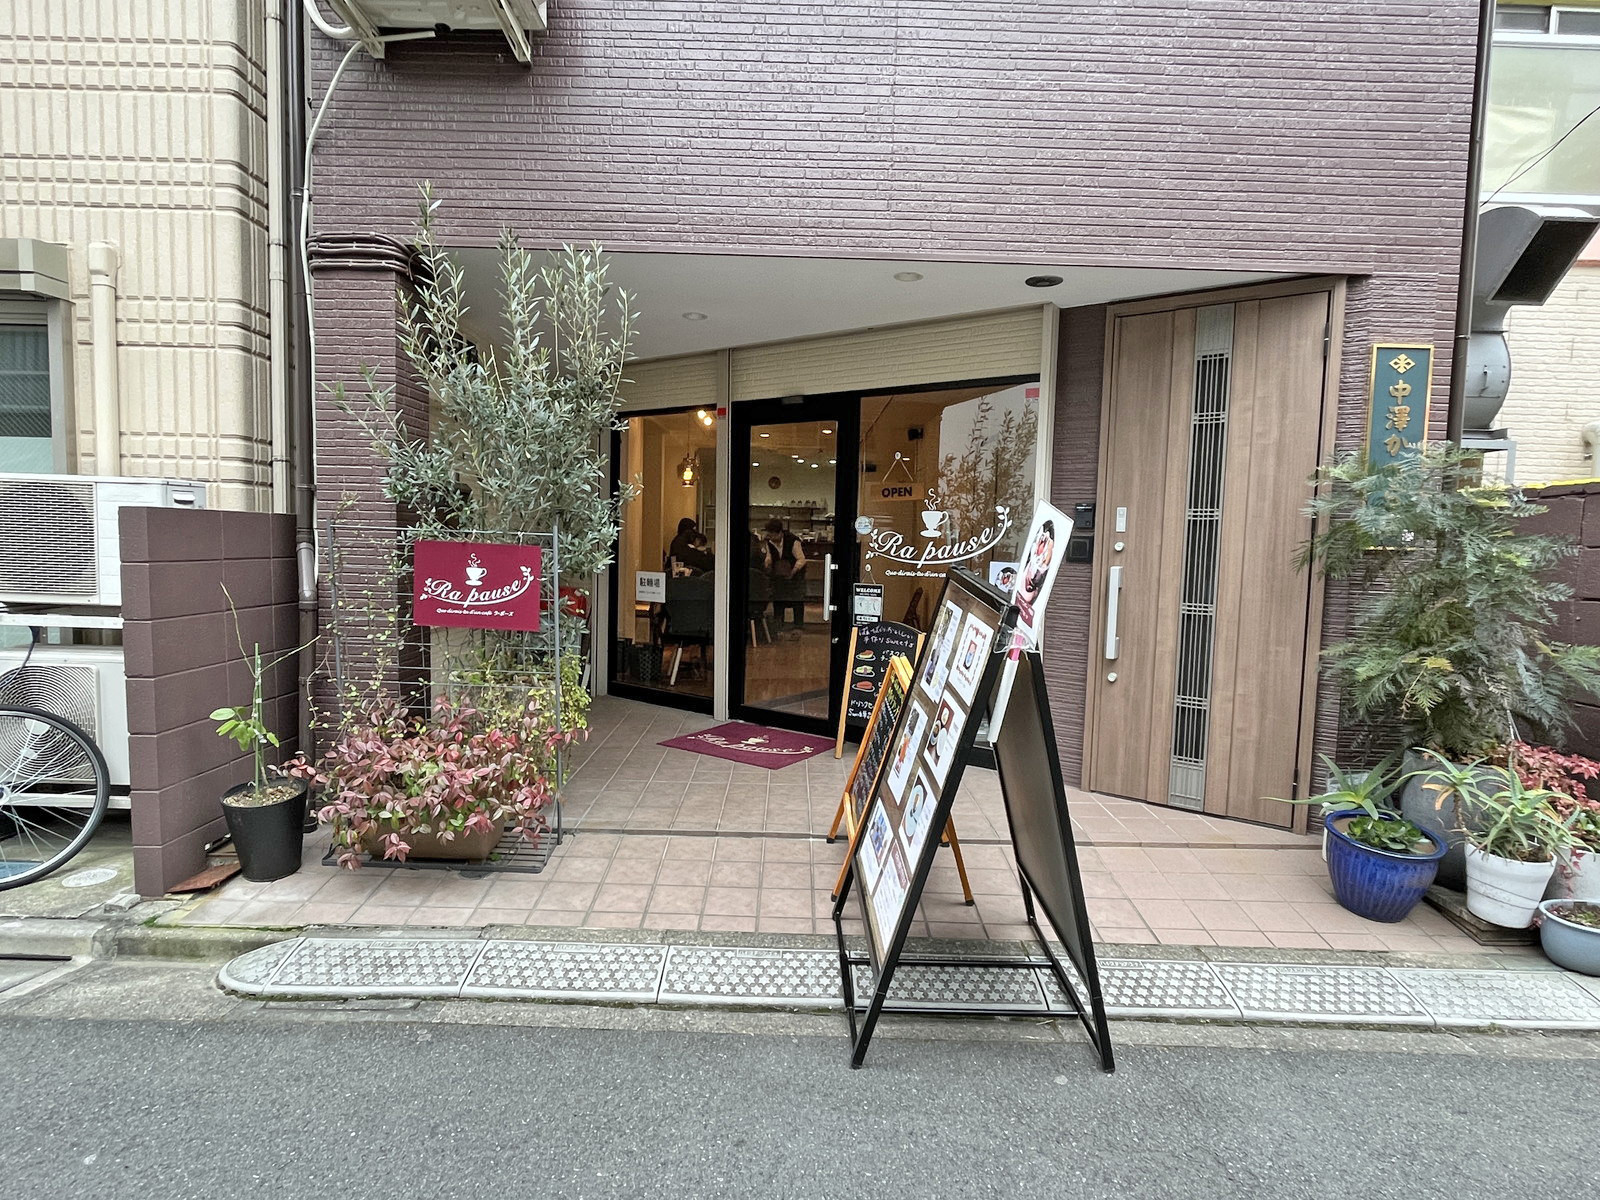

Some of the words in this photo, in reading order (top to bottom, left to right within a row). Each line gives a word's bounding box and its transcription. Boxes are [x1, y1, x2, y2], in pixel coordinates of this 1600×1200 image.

[881, 486, 913, 498] OPEN
[877, 531, 918, 559] Ra
[917, 526, 994, 569] pause
[430, 580, 463, 601] Ra
[463, 580, 521, 608] pause
